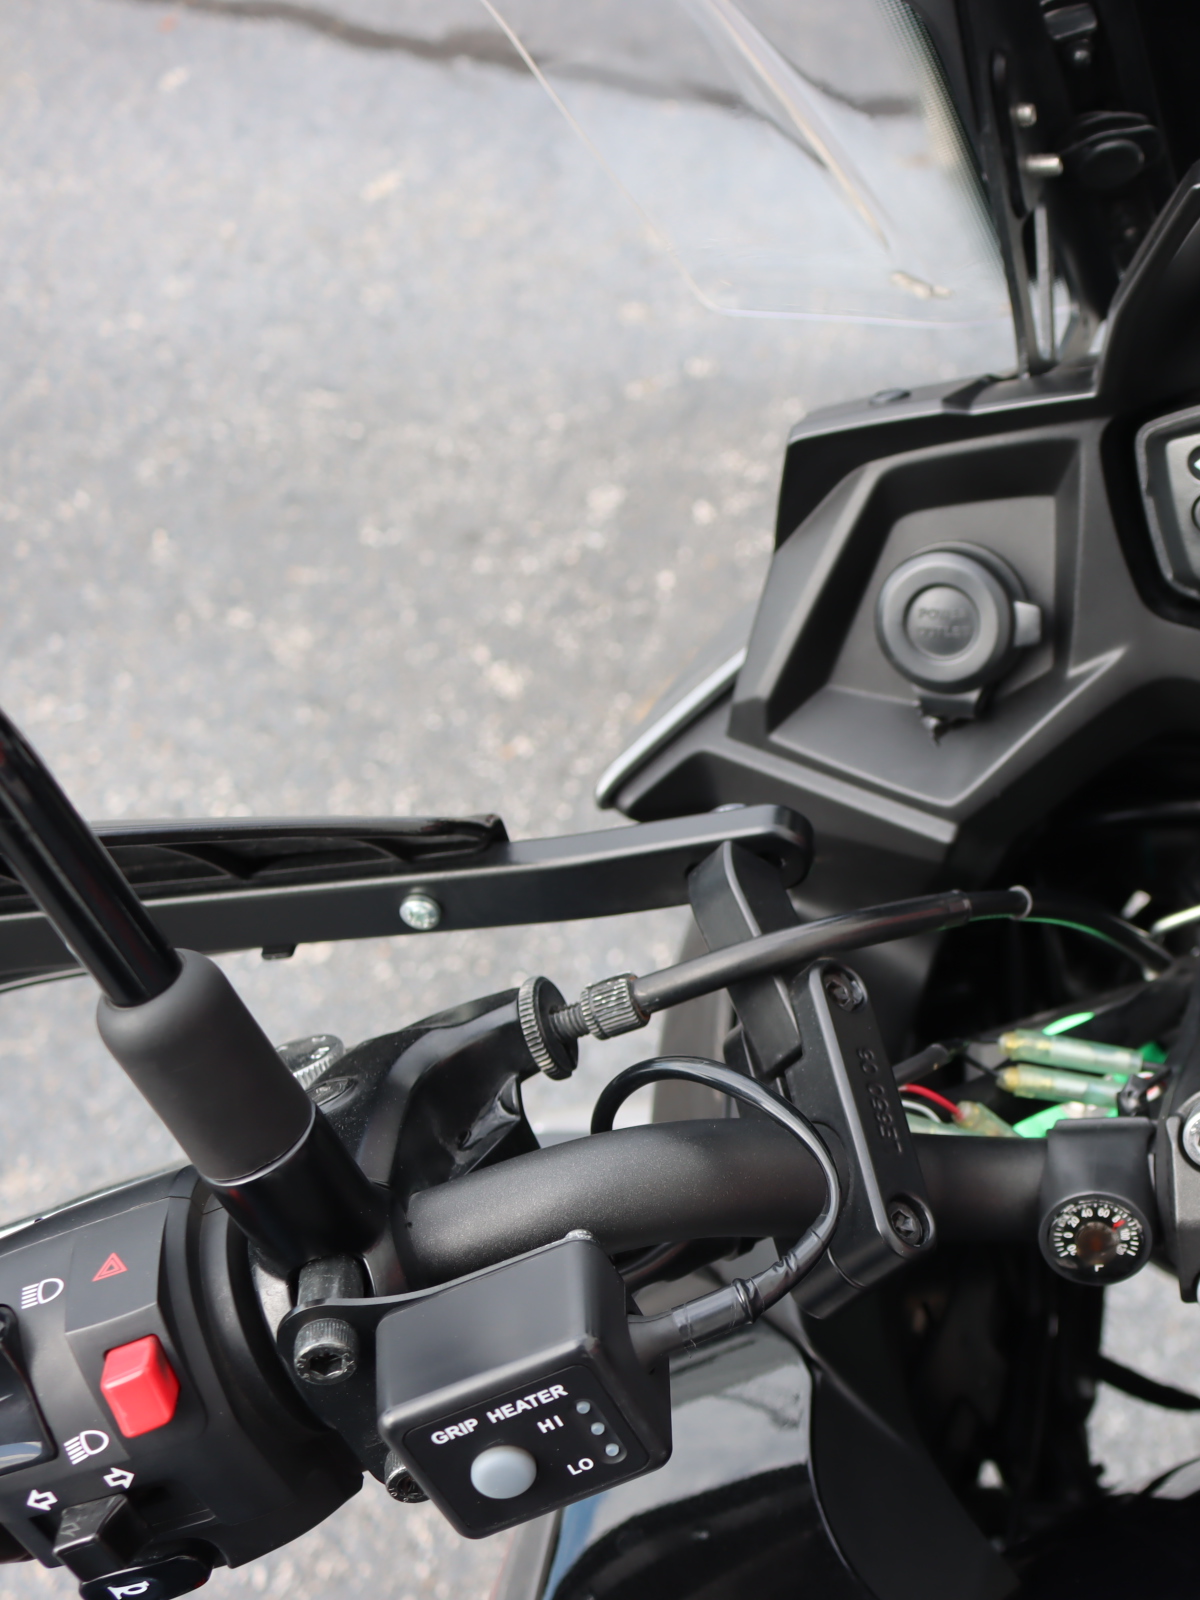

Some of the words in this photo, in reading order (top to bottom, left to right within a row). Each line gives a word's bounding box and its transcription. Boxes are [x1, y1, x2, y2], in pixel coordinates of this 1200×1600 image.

[430, 1418, 479, 1445] GRIP
[486, 1384, 569, 1424] HEATER
[537, 1414, 564, 1434] HI
[566, 1457, 595, 1476] LO
